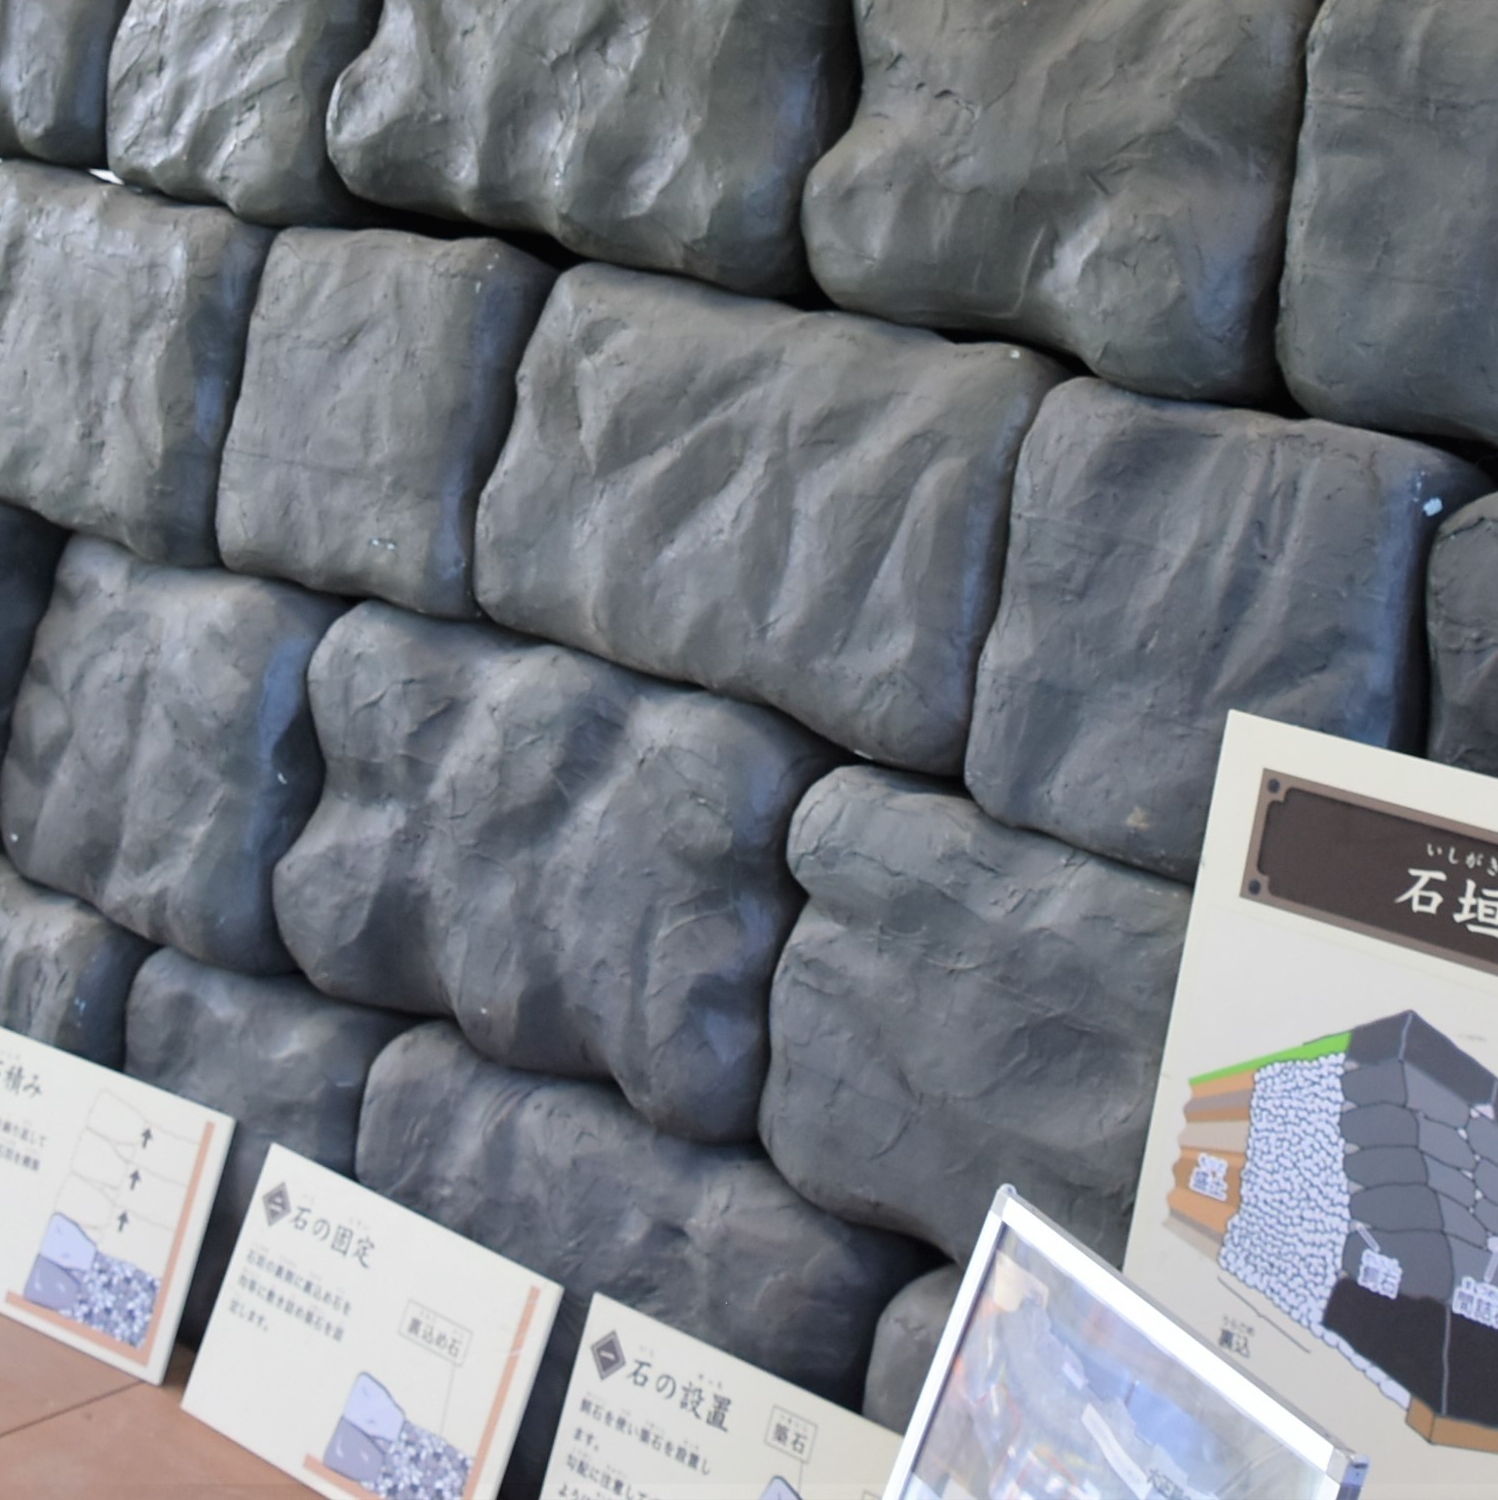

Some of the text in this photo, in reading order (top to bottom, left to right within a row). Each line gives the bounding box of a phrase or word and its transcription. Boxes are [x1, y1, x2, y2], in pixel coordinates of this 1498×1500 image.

[289, 1204, 376, 1270] 石の固定
[627, 1359, 732, 1433] 石の設置
